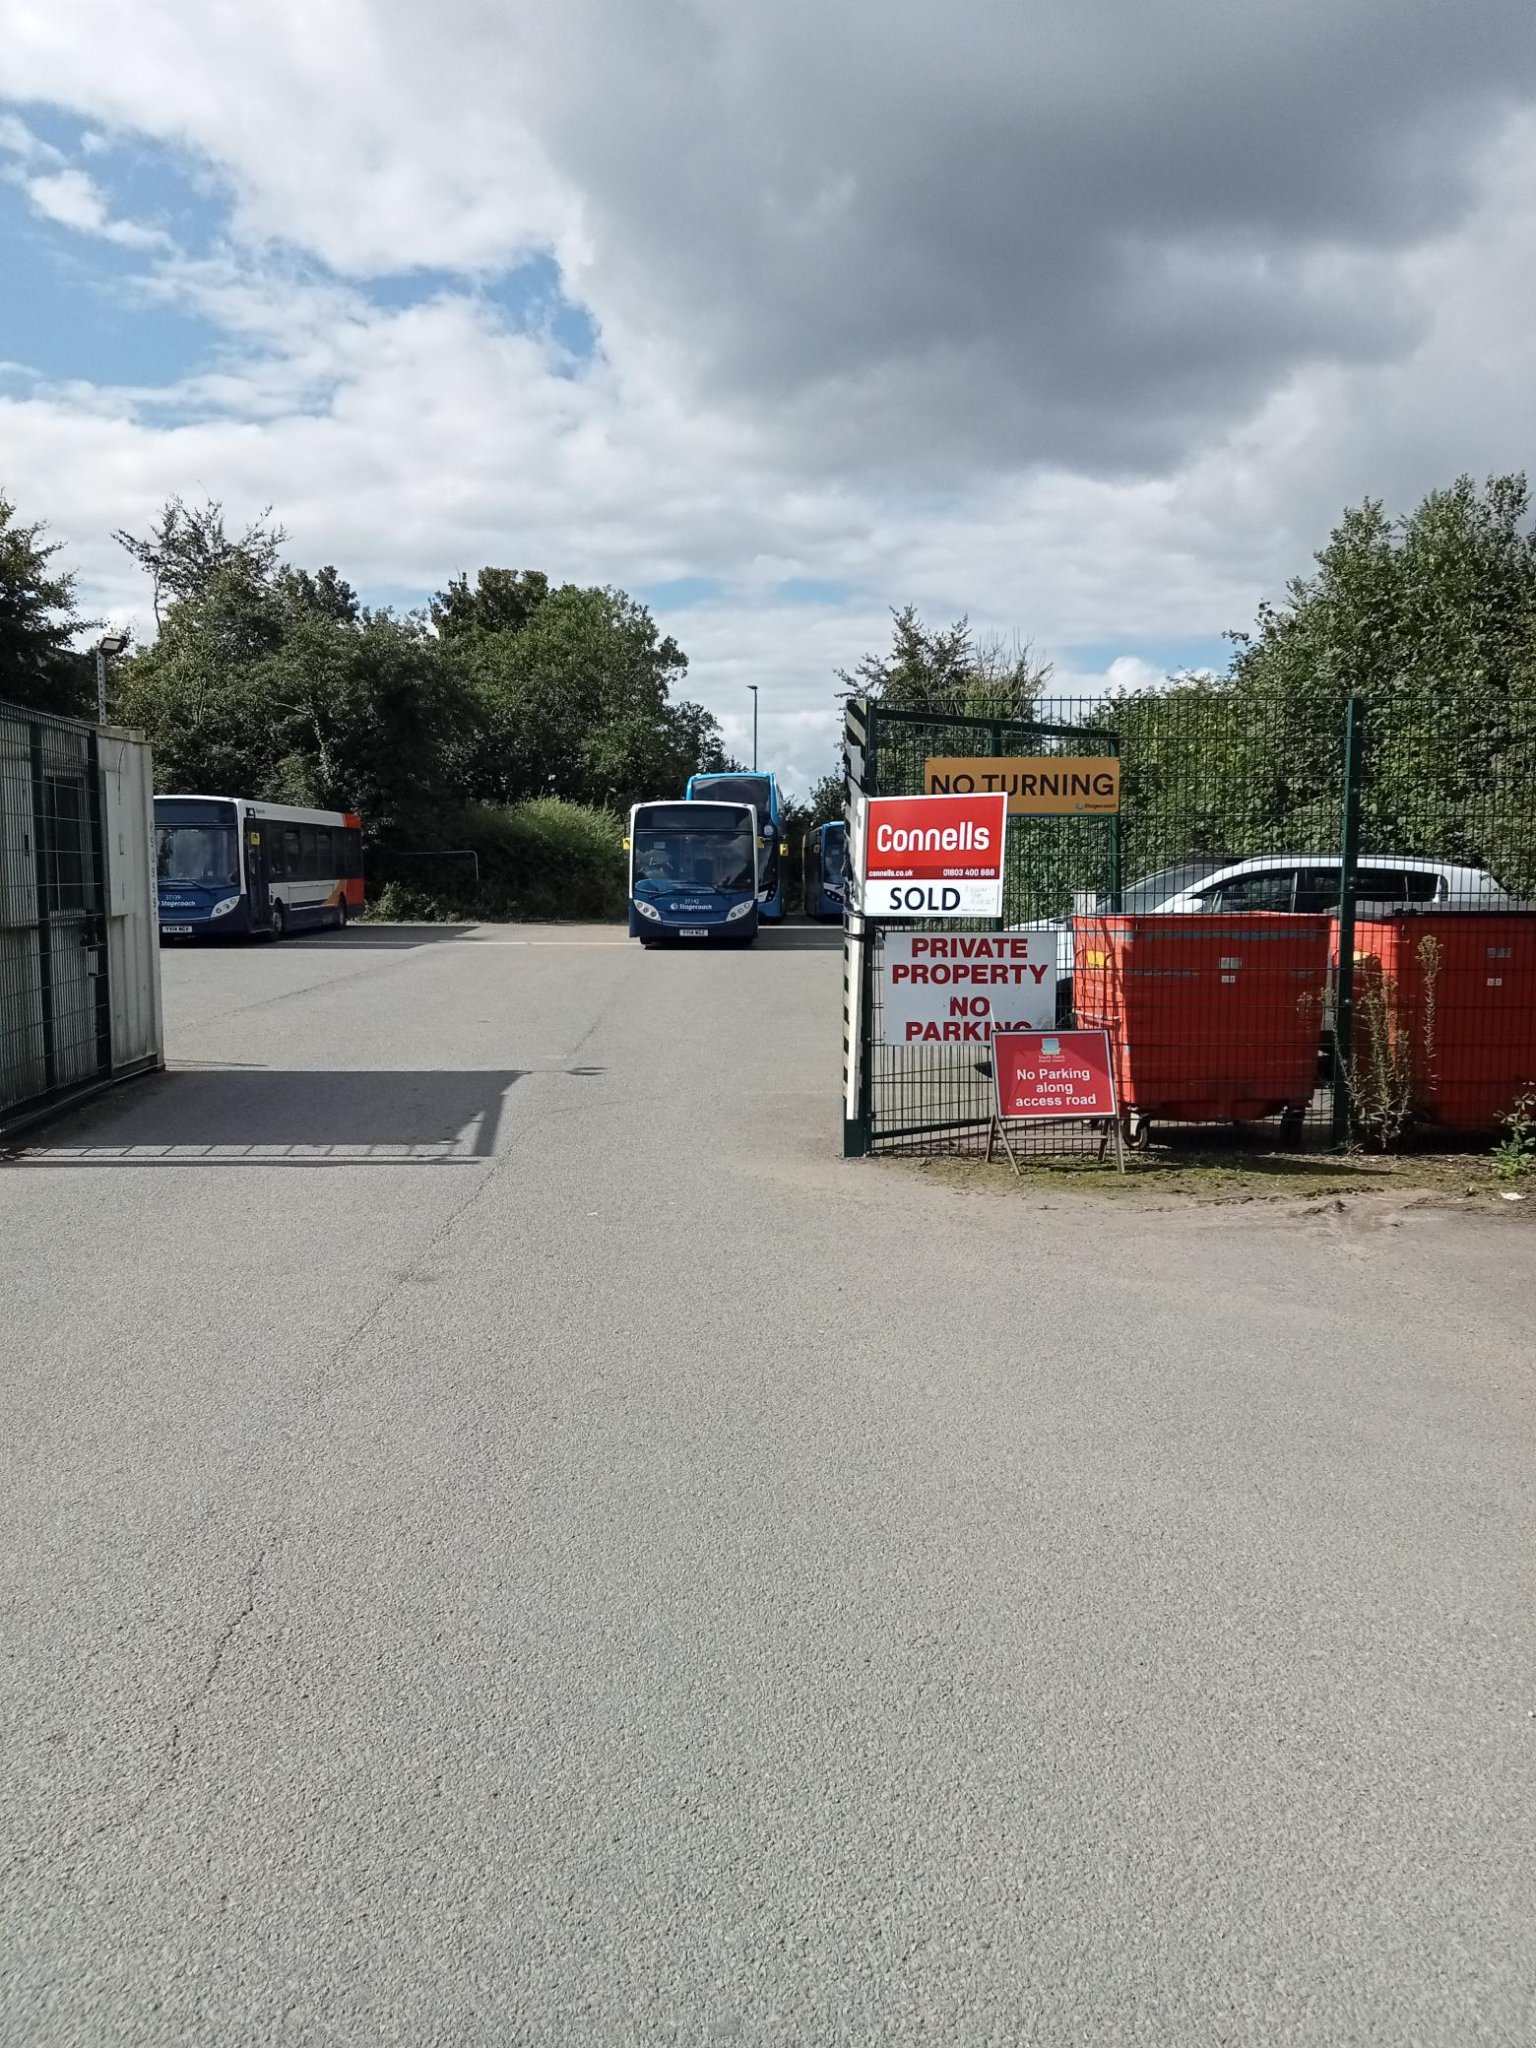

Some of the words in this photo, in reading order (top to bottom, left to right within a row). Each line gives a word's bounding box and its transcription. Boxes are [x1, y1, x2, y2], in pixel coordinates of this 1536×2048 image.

[931, 774, 975, 794] NO
[981, 773, 1115, 796] TURNING
[877, 821, 990, 853] Connells
[868, 869, 914, 877] connells.co.uk
[943, 868, 963, 877] 01803
[964, 868, 979, 877] 400
[889, 887, 961, 911] SOLD
[911, 938, 1028, 958] PRIVATE
[892, 964, 1049, 985] PROPERTY
[950, 996, 990, 1017] NO
[1017, 1069, 1035, 1080] No
[1039, 1068, 1090, 1081] Parking
[1036, 1081, 1073, 1095] along
[1015, 1096, 1062, 1107] access
[1065, 1093, 1096, 1106] road
